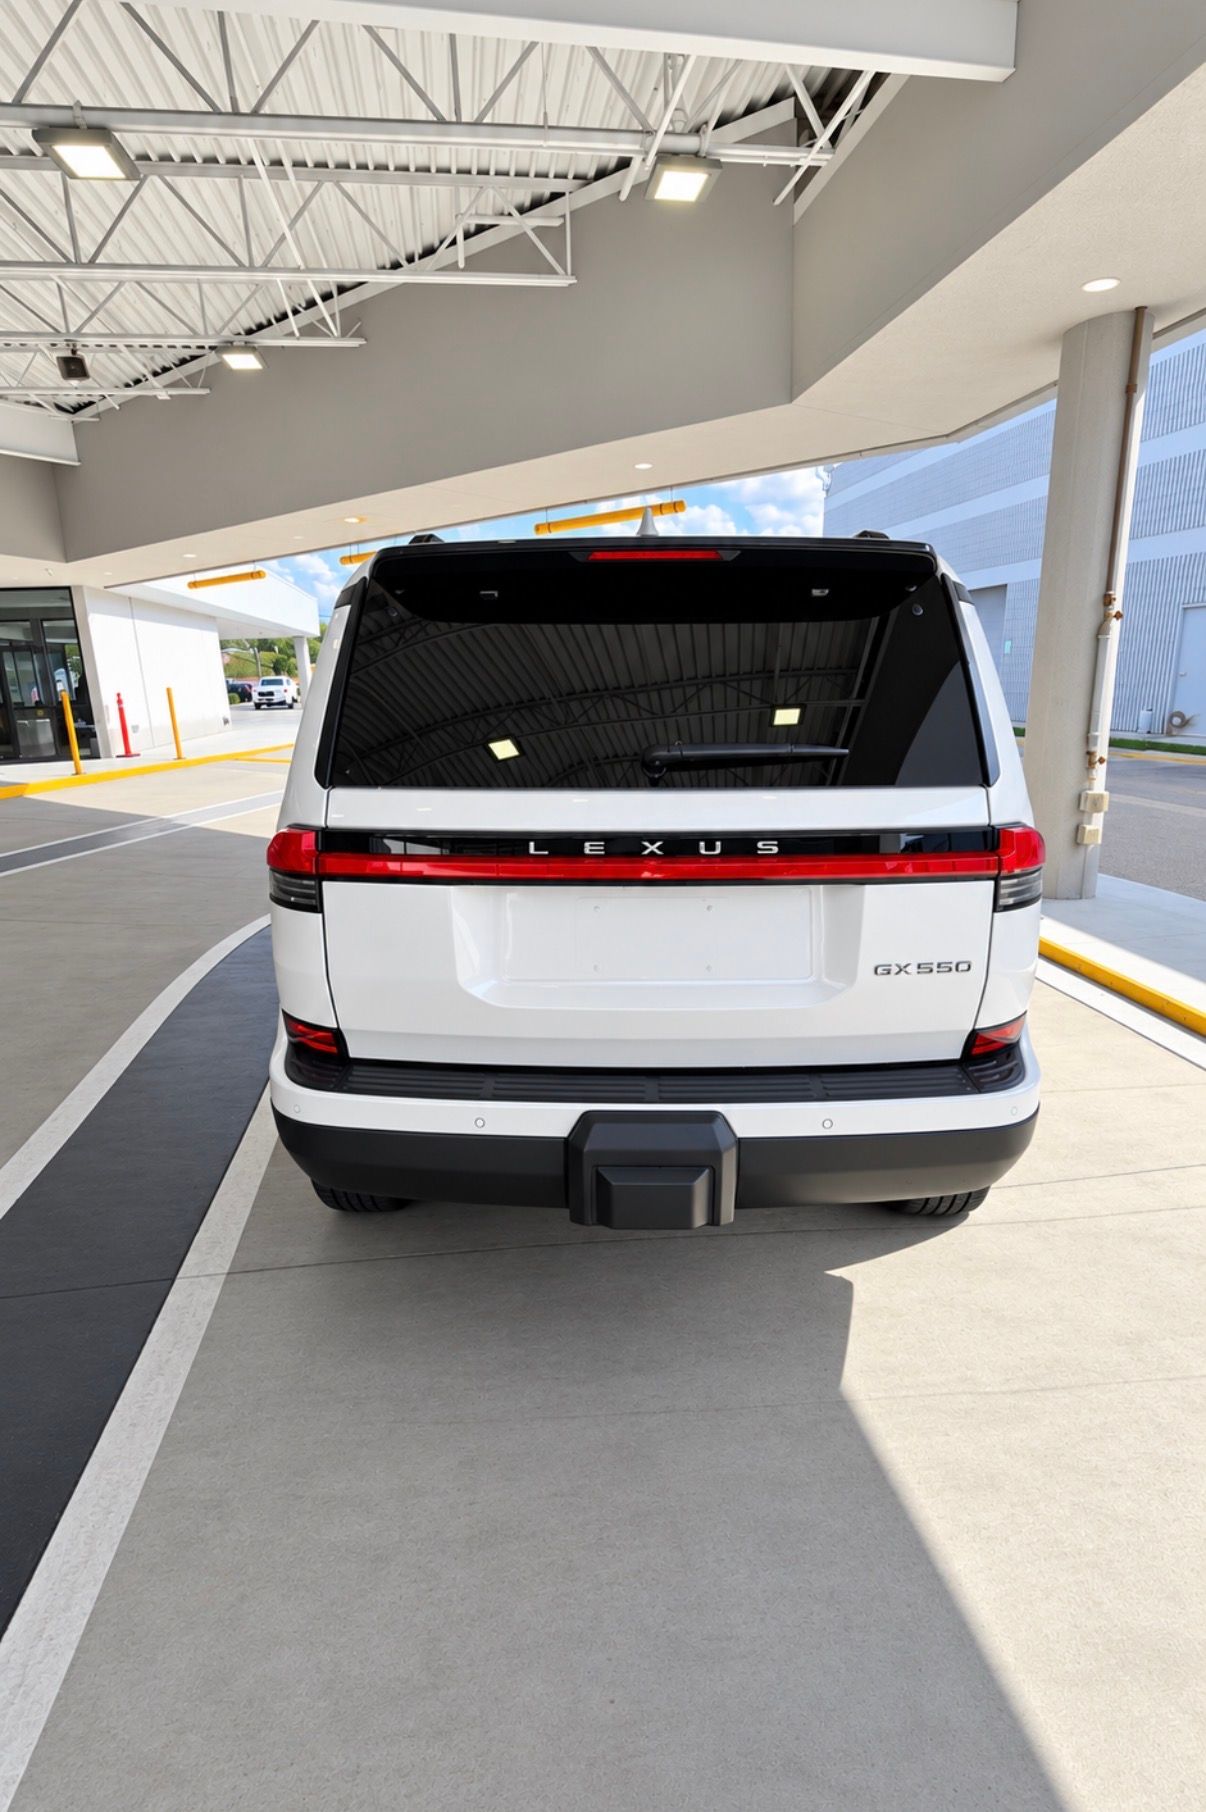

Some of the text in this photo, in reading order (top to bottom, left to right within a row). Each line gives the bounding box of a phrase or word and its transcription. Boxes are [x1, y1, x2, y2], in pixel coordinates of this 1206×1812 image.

[528, 841, 779, 855] LEXUS
[873, 960, 972, 976] GX 550
